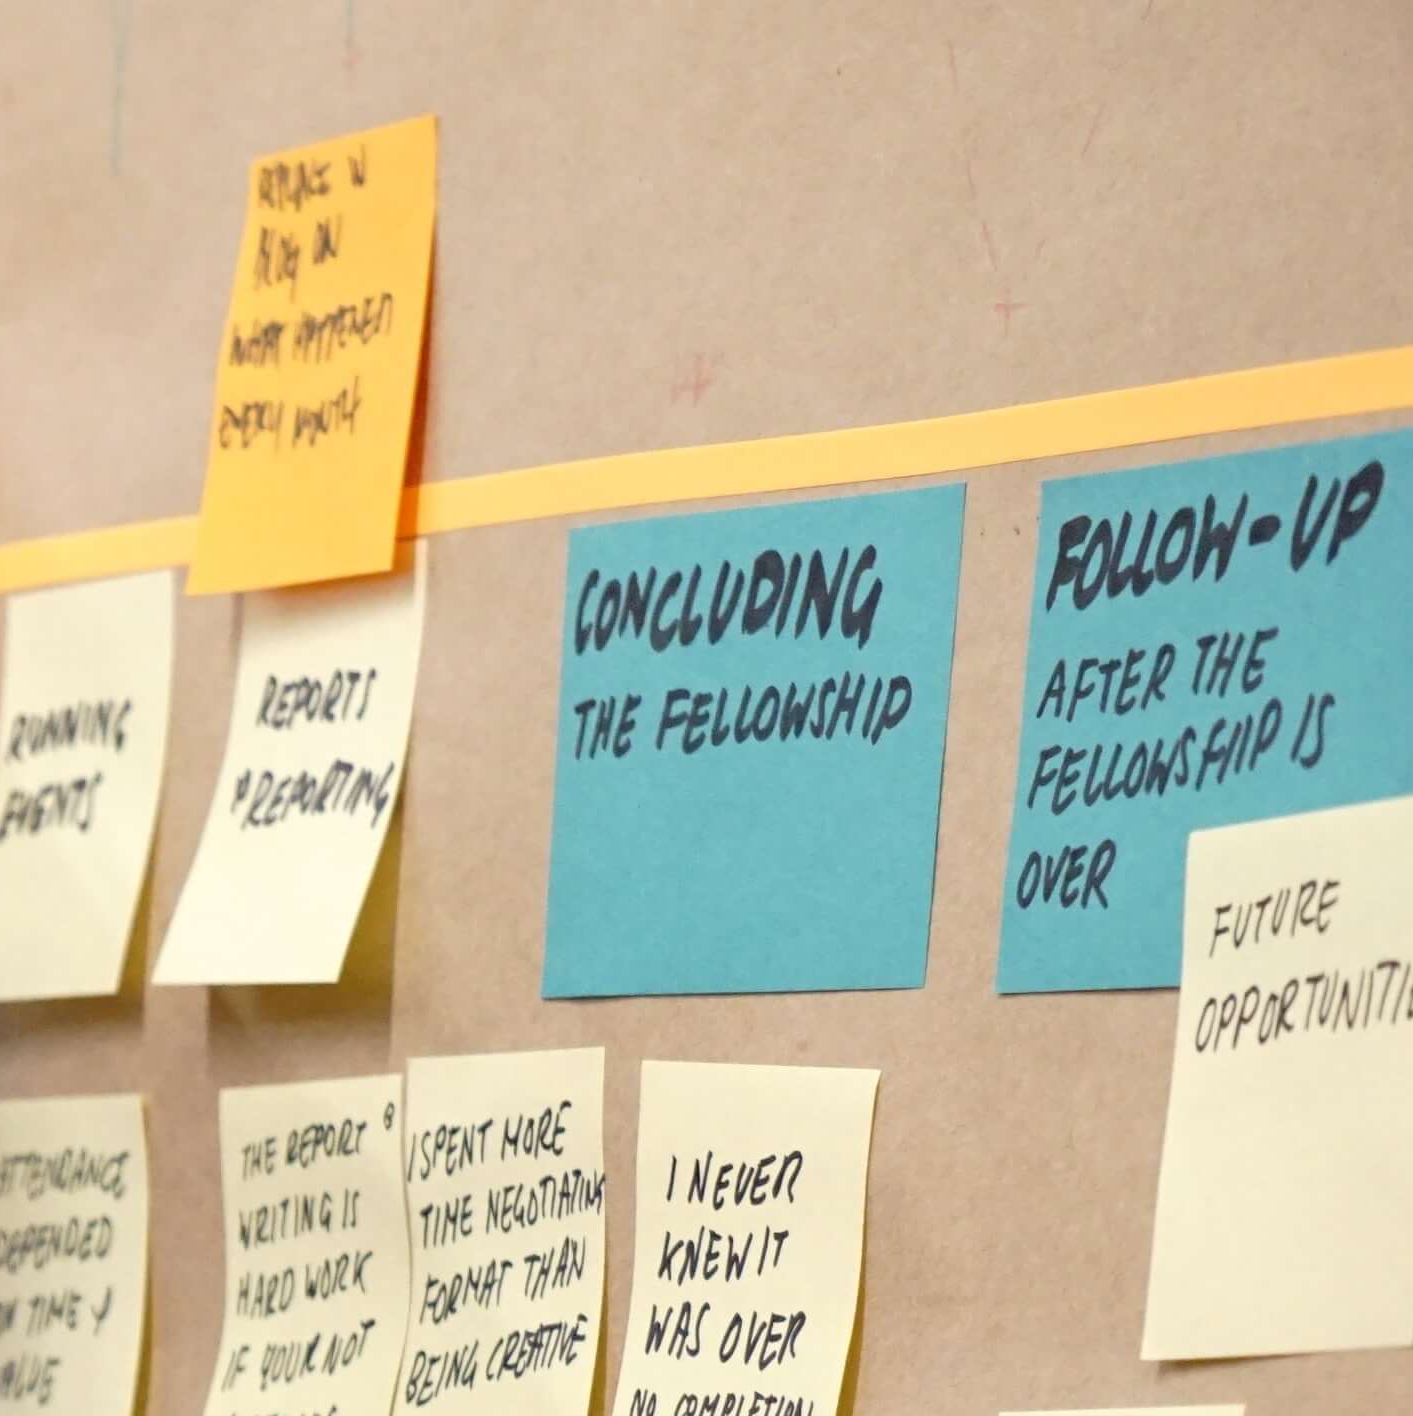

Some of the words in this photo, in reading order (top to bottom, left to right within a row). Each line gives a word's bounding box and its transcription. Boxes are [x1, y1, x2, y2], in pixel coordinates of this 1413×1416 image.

[1046, 460, 1385, 613] FOLLOW-UP
[574, 545, 883, 656] CONCLUDING
[255, 668, 377, 728] REPORTS
[1037, 643, 1176, 722] AFTER
[1192, 626, 1279, 698] THE
[5, 699, 133, 762] RUNNING
[574, 694, 642, 760] THE
[656, 671, 912, 755] FELLOWSHIP
[1028, 698, 1282, 816] FELLOWSHIP
[1291, 692, 1335, 769] IS
[1016, 838, 1116, 909] OVER
[1209, 878, 1340, 958] FUTURE
[241, 1137, 276, 1181] THE
[286, 1119, 367, 1169] REPORT
[407, 1132, 417, 1184] I
[420, 1118, 494, 1181] SPENT
[501, 1101, 572, 1161] MORE
[666, 1155, 678, 1201] I
[688, 1150, 803, 1210] NEVER
[239, 1194, 332, 1251] WRITING
[342, 1189, 359, 1229] IS
[420, 1197, 473, 1249] TIME
[237, 1269, 294, 1320] HARD
[304, 1251, 373, 1299] WORK
[420, 1260, 512, 1326] FORMAT
[524, 1236, 586, 1301] THAN
[658, 1225, 754, 1287] KNEW
[758, 1225, 789, 1276] IT
[27, 1289, 83, 1337] TIME
[645, 1301, 710, 1360] WAS
[719, 1310, 807, 1371] OVER
[222, 1344, 249, 1392] IF
[322, 1318, 375, 1375] NOT
[406, 1341, 477, 1407] BEING
[486, 1314, 588, 1382] CREATIVE
